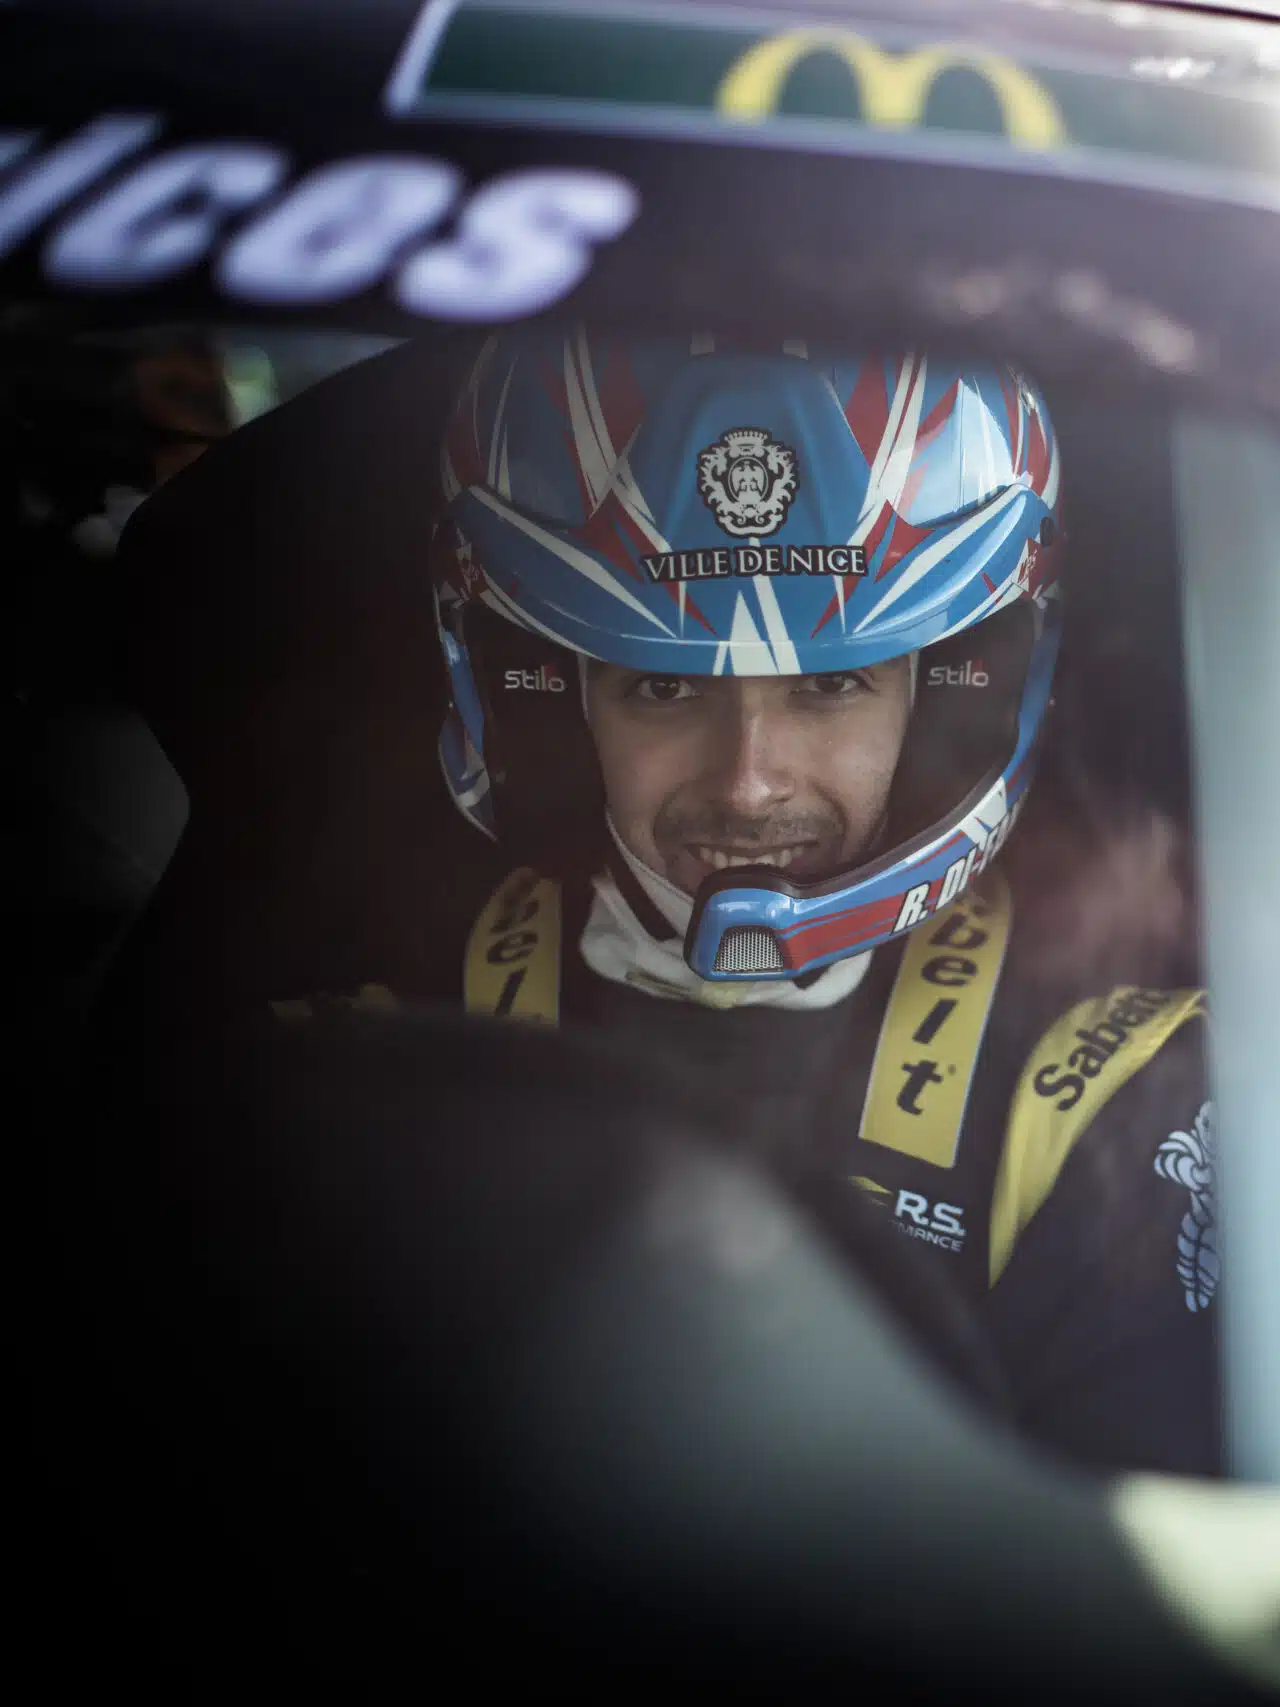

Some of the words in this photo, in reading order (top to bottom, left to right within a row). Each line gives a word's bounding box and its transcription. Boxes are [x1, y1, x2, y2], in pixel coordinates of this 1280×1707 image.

[644, 550, 729, 581] VILLE
[737, 548, 781, 573] DE
[789, 547, 866, 574] NICE
[504, 664, 565, 692] Stilo
[927, 659, 989, 688] Stilo
